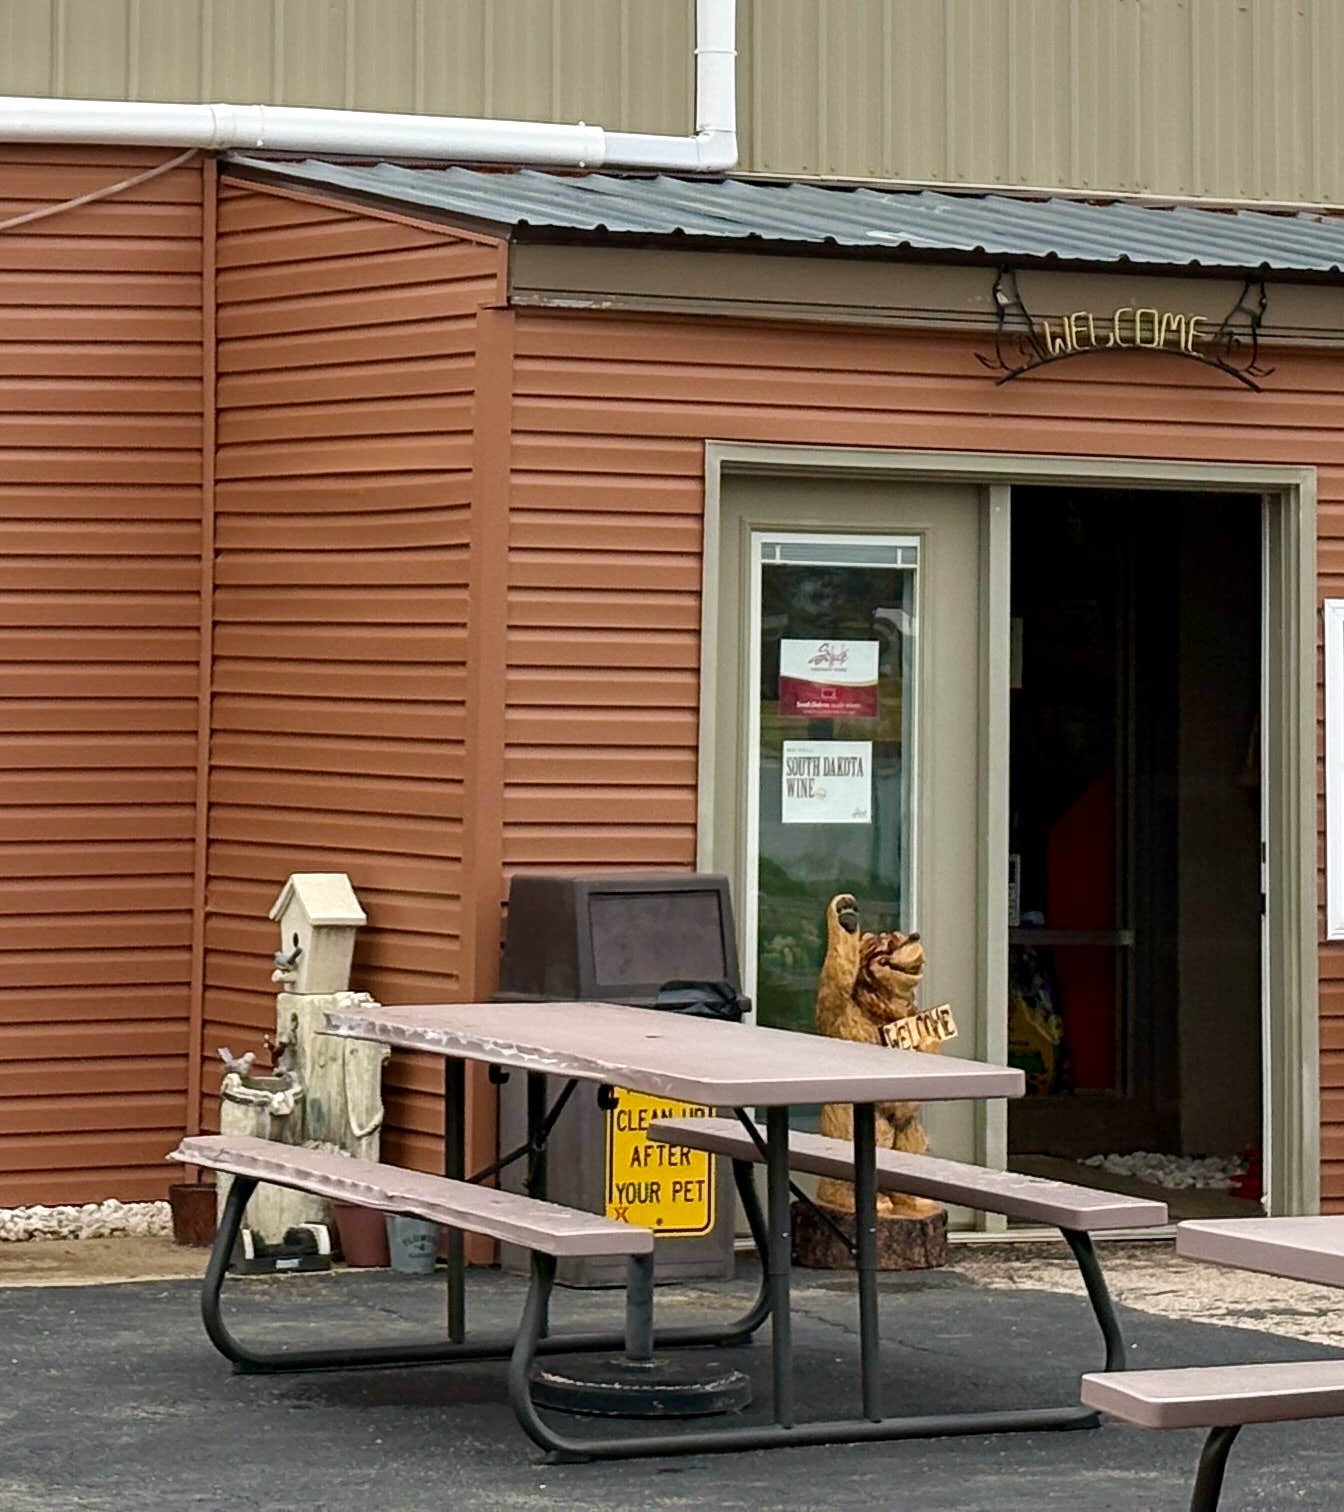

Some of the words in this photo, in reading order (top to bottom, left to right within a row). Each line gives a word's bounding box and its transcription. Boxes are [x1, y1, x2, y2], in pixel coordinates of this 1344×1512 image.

[1044, 307, 1208, 356] WELCOME
[786, 756, 820, 777] SOUTH
[824, 756, 864, 777] DAKOTA
[786, 778, 816, 799] WINE
[630, 1145, 692, 1169] AFTER
[615, 1181, 661, 1205] YOUR
[672, 1180, 705, 1203] PET
